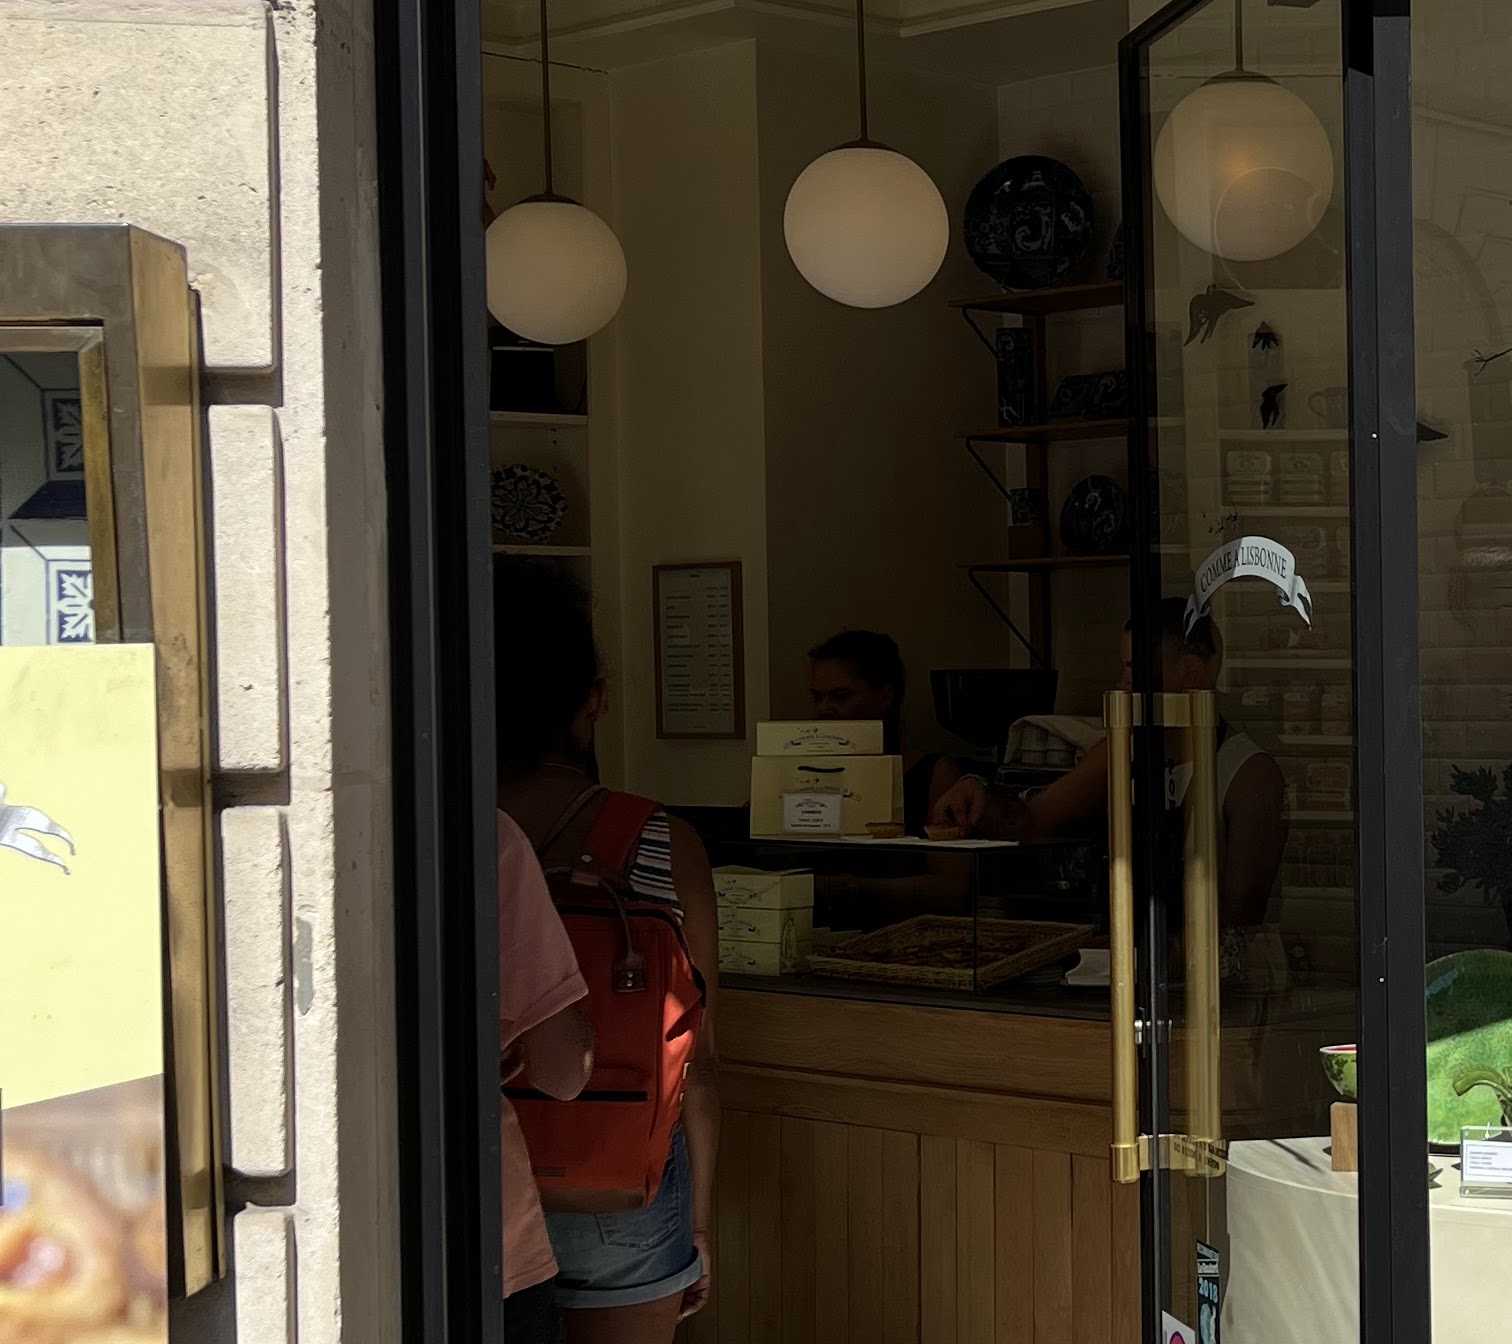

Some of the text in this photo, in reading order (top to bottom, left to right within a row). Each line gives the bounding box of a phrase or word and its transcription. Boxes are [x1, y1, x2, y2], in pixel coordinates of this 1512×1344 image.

[1200, 551, 1233, 592] COMME
[1241, 546, 1288, 579] LISBONNE
[1198, 1277, 1218, 1303] 2018
